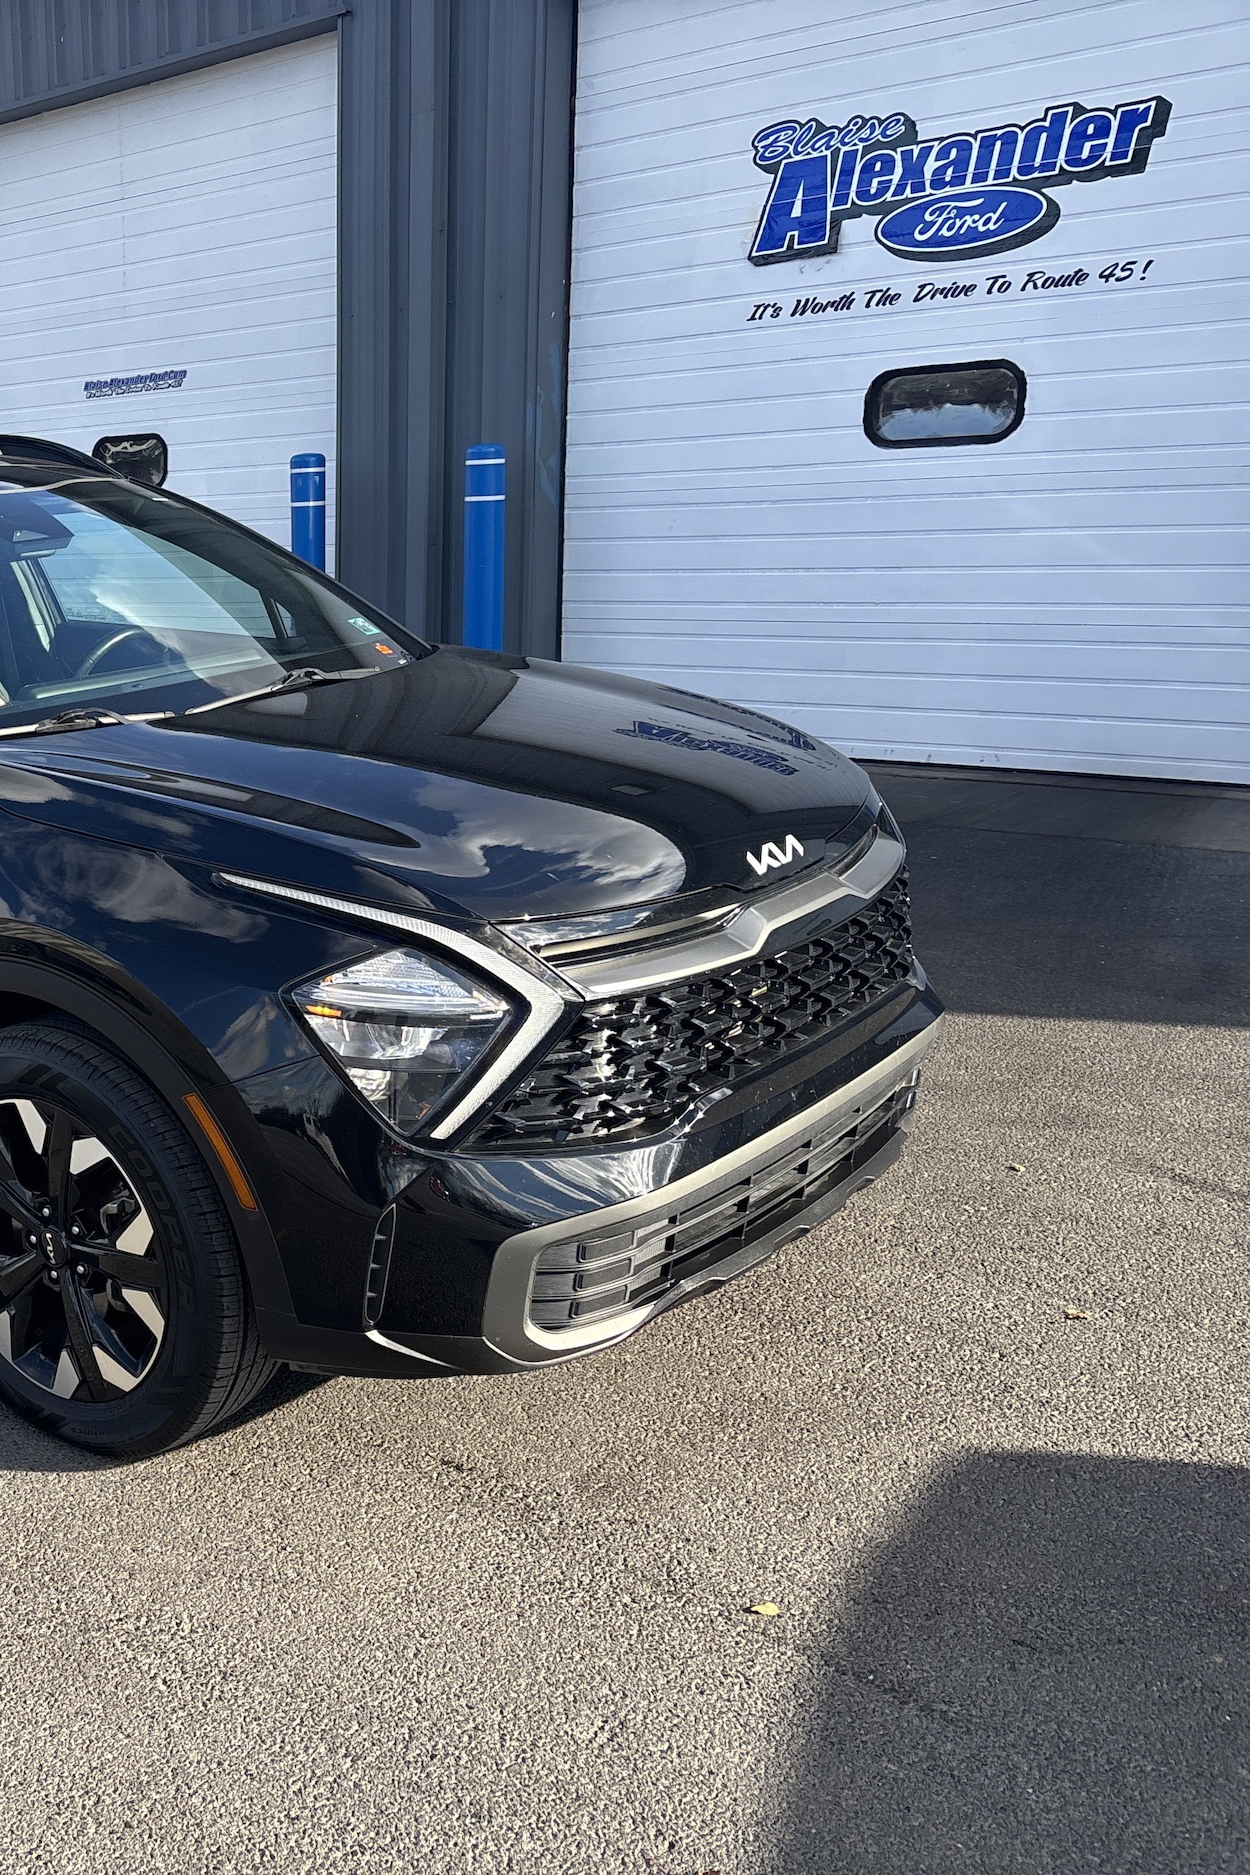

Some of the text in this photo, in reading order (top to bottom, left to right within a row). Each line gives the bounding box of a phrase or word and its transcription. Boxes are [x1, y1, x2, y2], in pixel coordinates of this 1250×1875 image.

[754, 112, 906, 164] Blaise
[751, 96, 1160, 257] Alexander
[913, 197, 1007, 241] Ford
[746, 302, 783, 322] It's
[790, 291, 856, 317] Worth
[863, 287, 902, 309] The
[912, 281, 978, 303] Drive
[985, 274, 1012, 295] To
[1020, 268, 1090, 291] Route
[108, 1124, 195, 1313] COOPER
